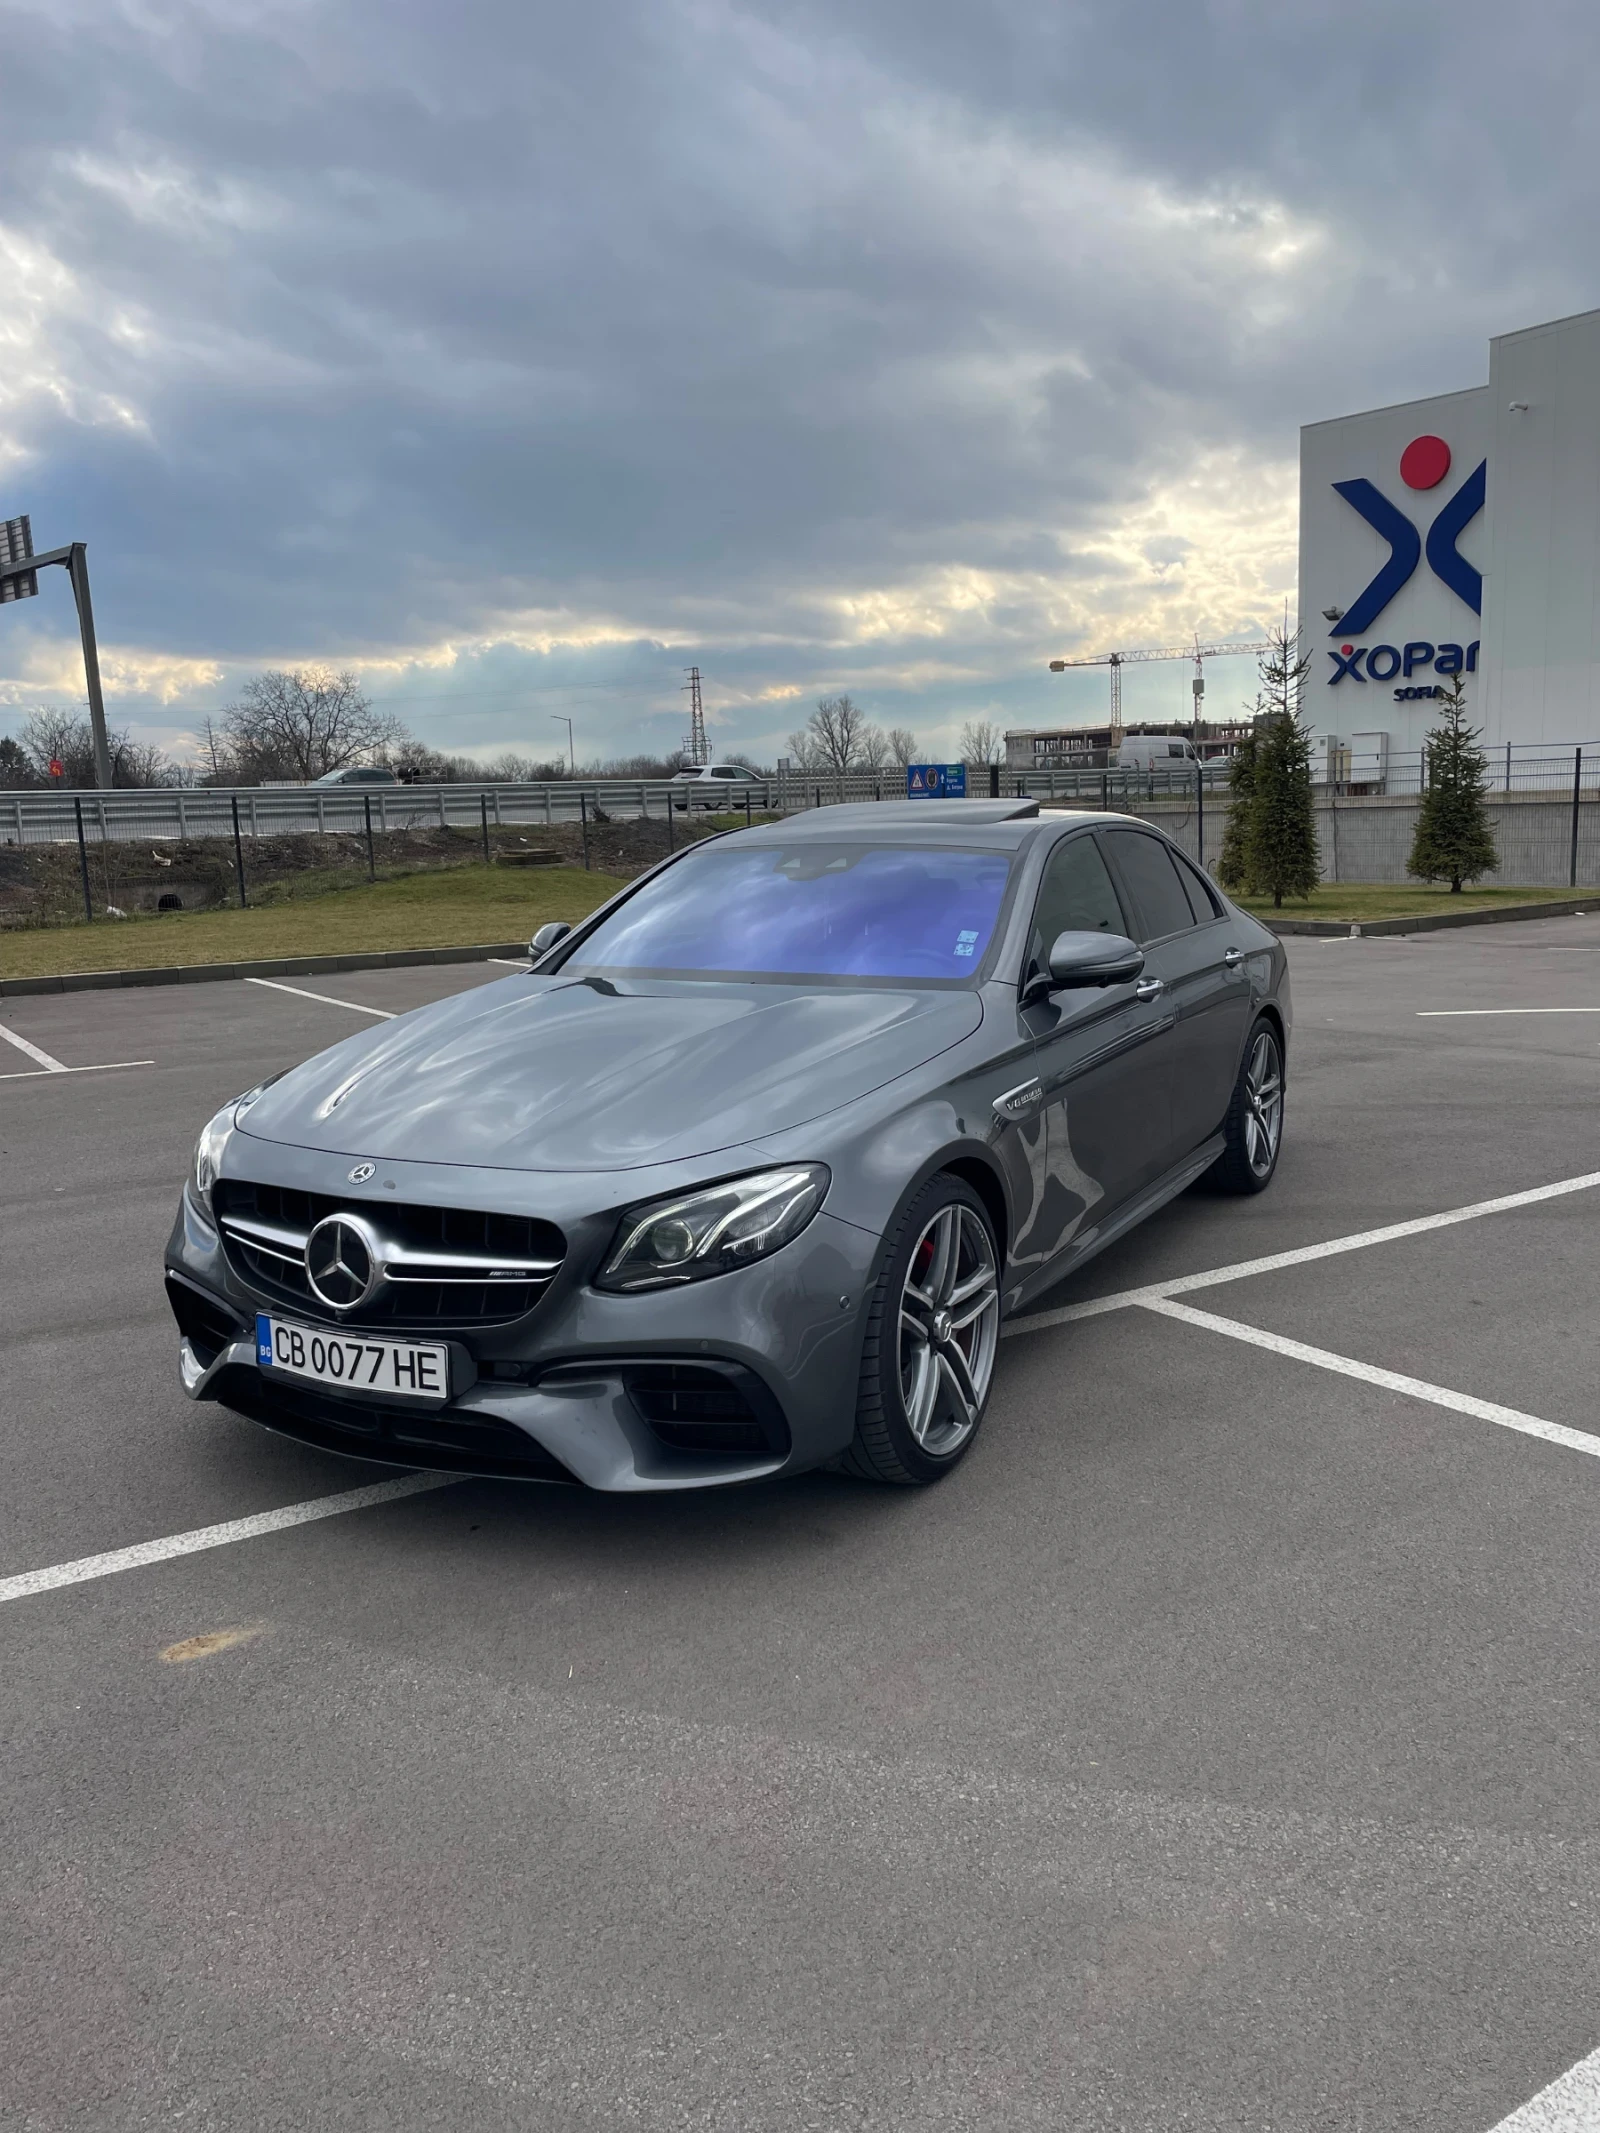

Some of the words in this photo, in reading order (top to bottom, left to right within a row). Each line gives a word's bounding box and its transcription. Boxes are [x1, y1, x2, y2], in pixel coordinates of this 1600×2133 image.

[260, 1345, 271, 1358] BG
[275, 1326, 306, 1368] CB
[311, 1337, 385, 1383] 0077
[393, 1349, 440, 1391] HE
